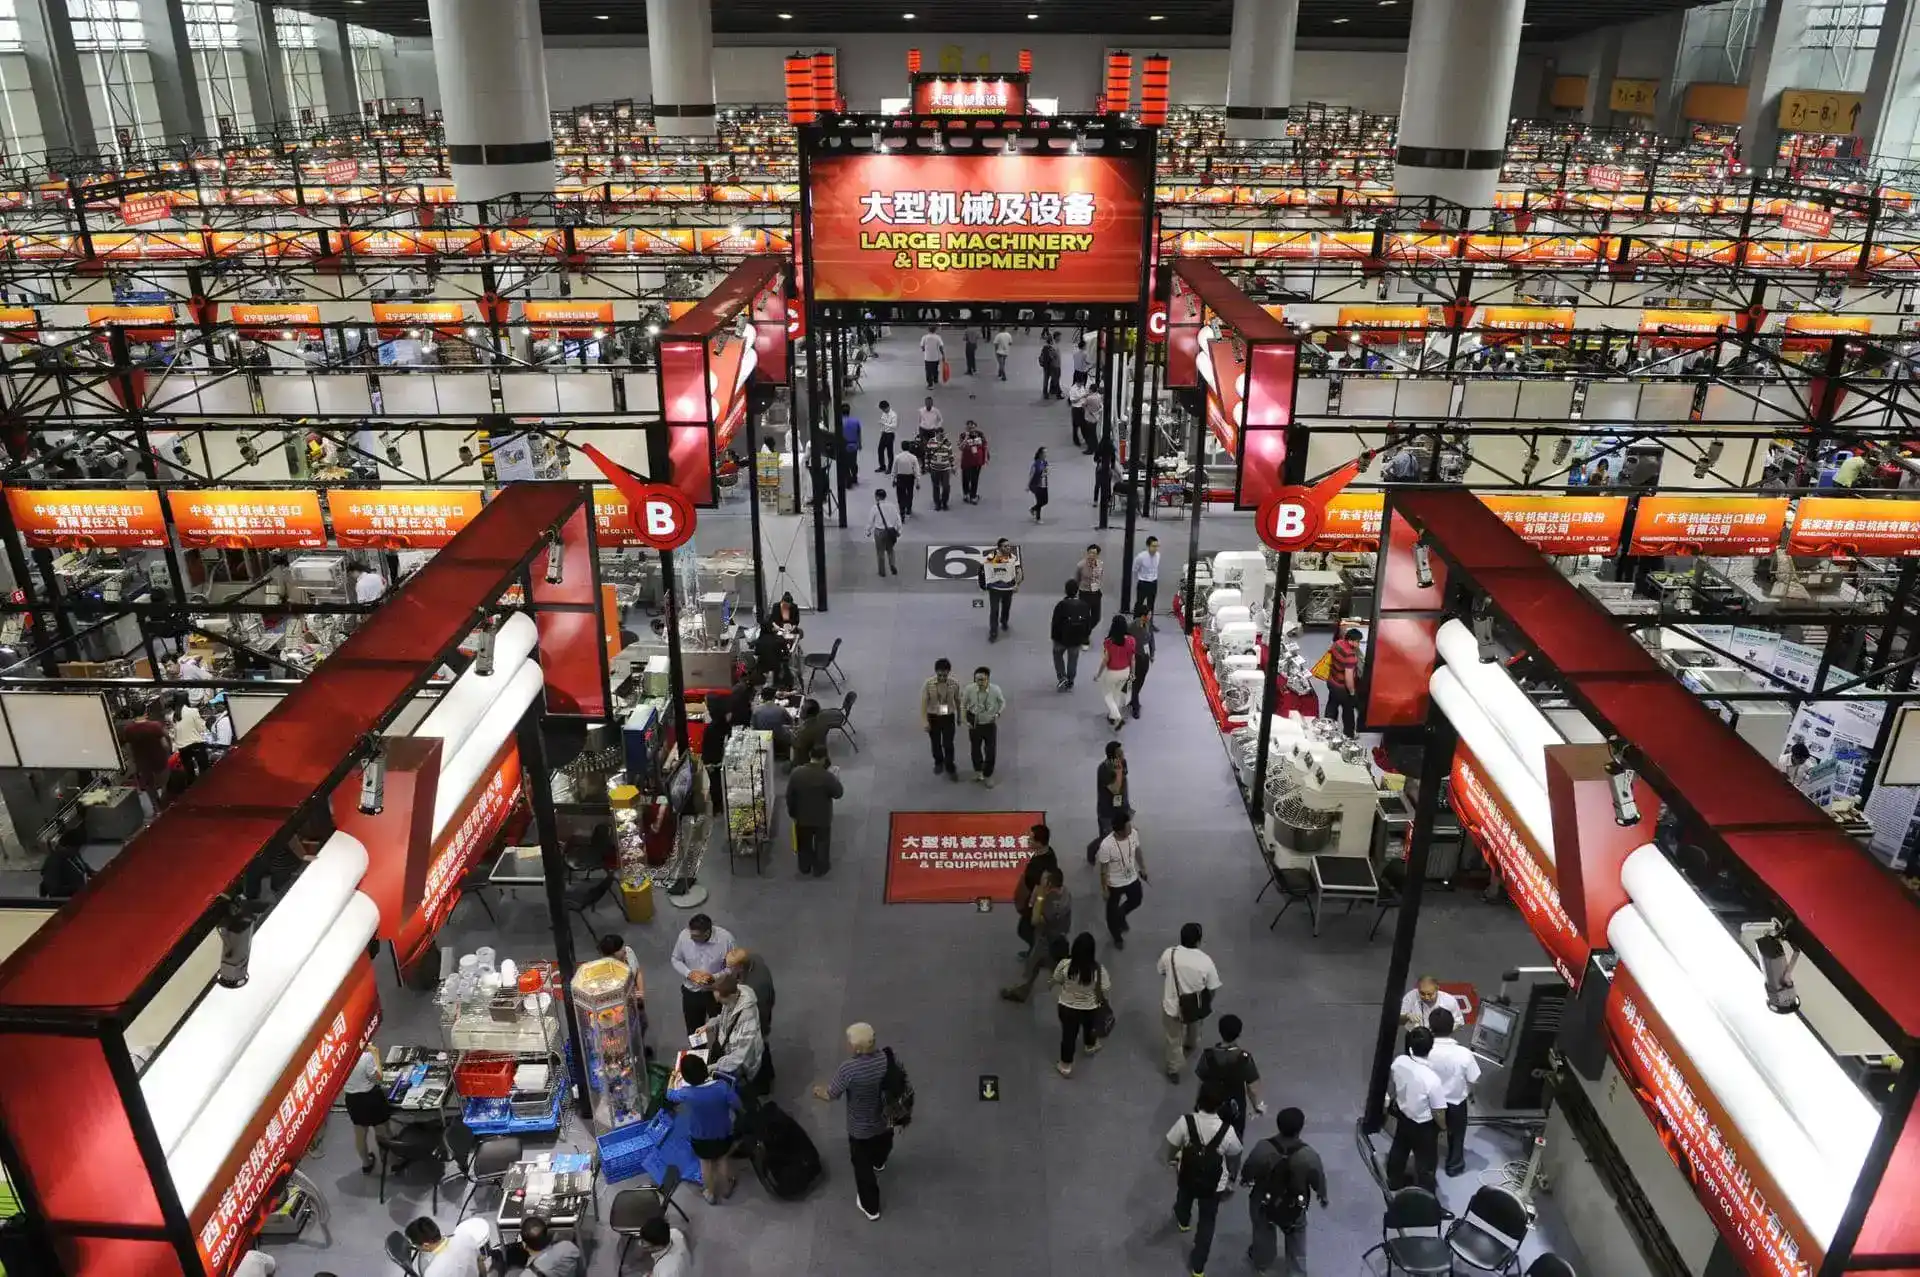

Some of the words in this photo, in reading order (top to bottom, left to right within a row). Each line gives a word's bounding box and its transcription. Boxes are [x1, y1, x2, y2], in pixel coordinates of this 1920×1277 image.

[859, 191, 1096, 226] 大型机械及设备
[860, 232, 940, 250] LARGE
[951, 233, 1093, 252] MACHINERY
[894, 253, 913, 269] &
[918, 252, 1060, 270] EQUIPMENT
[1149, 312, 1166, 334] C
[349, 504, 464, 516] 中设通用机械进出口
[646, 501, 676, 535] B
[1654, 512, 1767, 524] 广东省机械进出口股份
[56, 517, 128, 528] 有限责任公司
[211, 517, 286, 528] 有限责任公司
[371, 517, 447, 528] 有限责任公司
[1276, 504, 1306, 538] B
[1523, 523, 1569, 534] 有限公司
[1686, 525, 1731, 535] 有限公司
[901, 851, 948, 860] LARGE
[952, 851, 1036, 860] MACHINERY
[919, 860, 929, 868] &
[935, 860, 1019, 869] EQUIPMENT
[201, 1011, 347, 1252] 西诺控股集团有限公司
[1655, 1096, 1683, 1139] IMPORT
[1688, 1149, 1720, 1197] EXPORT
[1684, 1116, 1750, 1220] METAL-FORMING
[211, 1224, 238, 1268] SINO
[237, 1145, 287, 1223] HOLDINGS
[285, 1094, 316, 1144] GROUP
